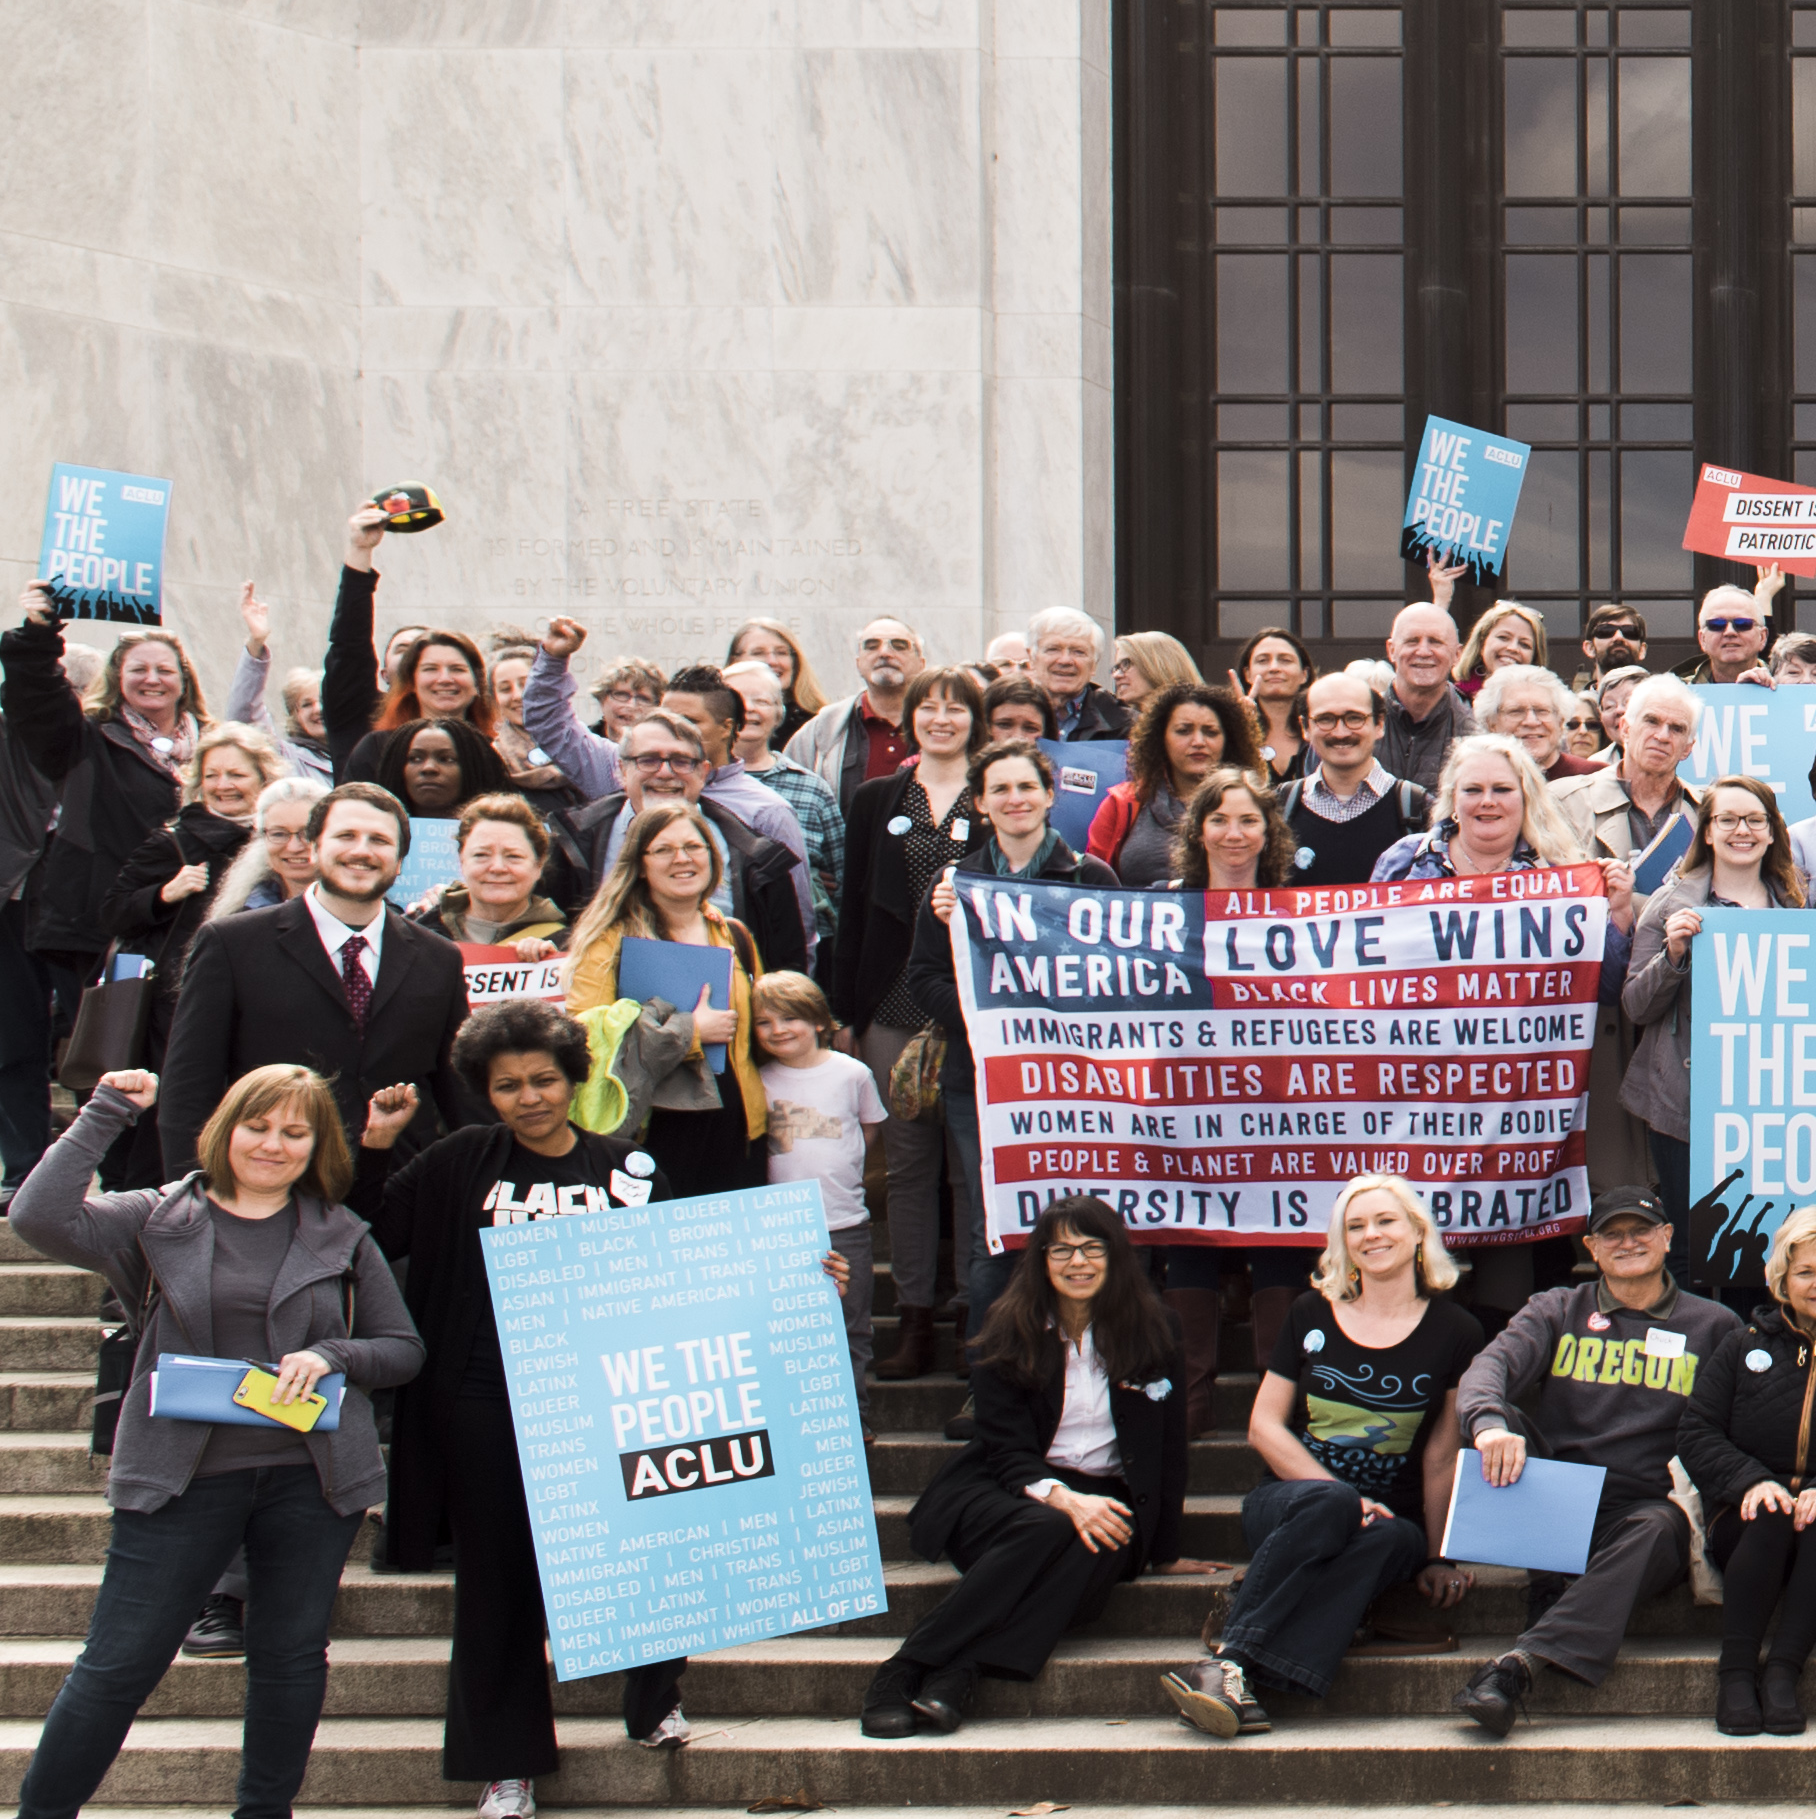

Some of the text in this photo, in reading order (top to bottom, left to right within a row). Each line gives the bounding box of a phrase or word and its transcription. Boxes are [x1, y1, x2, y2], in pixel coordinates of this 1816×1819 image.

[1429, 429, 1471, 472] WE
[1486, 447, 1521, 467] ACLU
[60, 476, 105, 516] WE
[125, 487, 162, 503] ACLU
[1421, 463, 1469, 507] THE
[1706, 469, 1740, 486] ACLU
[607, 499, 669, 517] FREE
[684, 499, 761, 517] STATE
[1412, 497, 1503, 553] PEOPLE
[1736, 500, 1803, 516] DISSENT
[54, 512, 107, 554] THE
[518, 538, 618, 557] FORMED
[629, 538, 675, 557] AND
[1739, 533, 1815, 550] PATRIOTIC
[48, 550, 154, 596] PEOPLE
[514, 577, 836, 596] BY THE VOLUNTARY UNION
[626, 617, 704, 634] WHOLE
[1225, 871, 1579, 916] ALL PEOPLE ARE EQUAL
[969, 881, 1184, 952] IN OUR
[1226, 905, 1587, 971] LOVE WINS
[465, 966, 560, 994] SENT IS
[991, 953, 1191, 997] AMERICA
[1231, 971, 1571, 1006] BLACK LIVES MATTER
[1713, 933, 1809, 1016] WE
[1002, 1014, 1584, 1049] IMMIGRANTS & REFUGEES ARE WELCOME
[1021, 1060, 1574, 1099] DISABILITIES ARE RESPECTED
[1011, 1111, 1113, 1134] WOMEN
[1132, 1114, 1176, 1139] ARE
[1196, 1114, 1222, 1138] IN
[1241, 1112, 1346, 1136] CHARGE
[1363, 1112, 1393, 1135] OF
[1409, 1112, 1483, 1136] THEIR
[1029, 1150, 1119, 1173] PEOPLE
[1135, 1152, 1149, 1172] &
[1163, 1154, 1254, 1176] PLANET
[1271, 1153, 1315, 1174] ARE
[1330, 1152, 1408, 1173] VALUED
[1424, 1153, 1482, 1175] OVER
[489, 1225, 557, 1248] WOMEN
[581, 1212, 650, 1233] MUSLIM
[672, 1200, 731, 1221] QUEER
[753, 1188, 811, 1209] LATINX
[1273, 1191, 1307, 1227] IS
[600, 1332, 756, 1397] WE THE
[611, 1382, 766, 1448] PEOPLE
[632, 1436, 763, 1495] ACLU
[791, 1594, 877, 1627] ALL OF US
